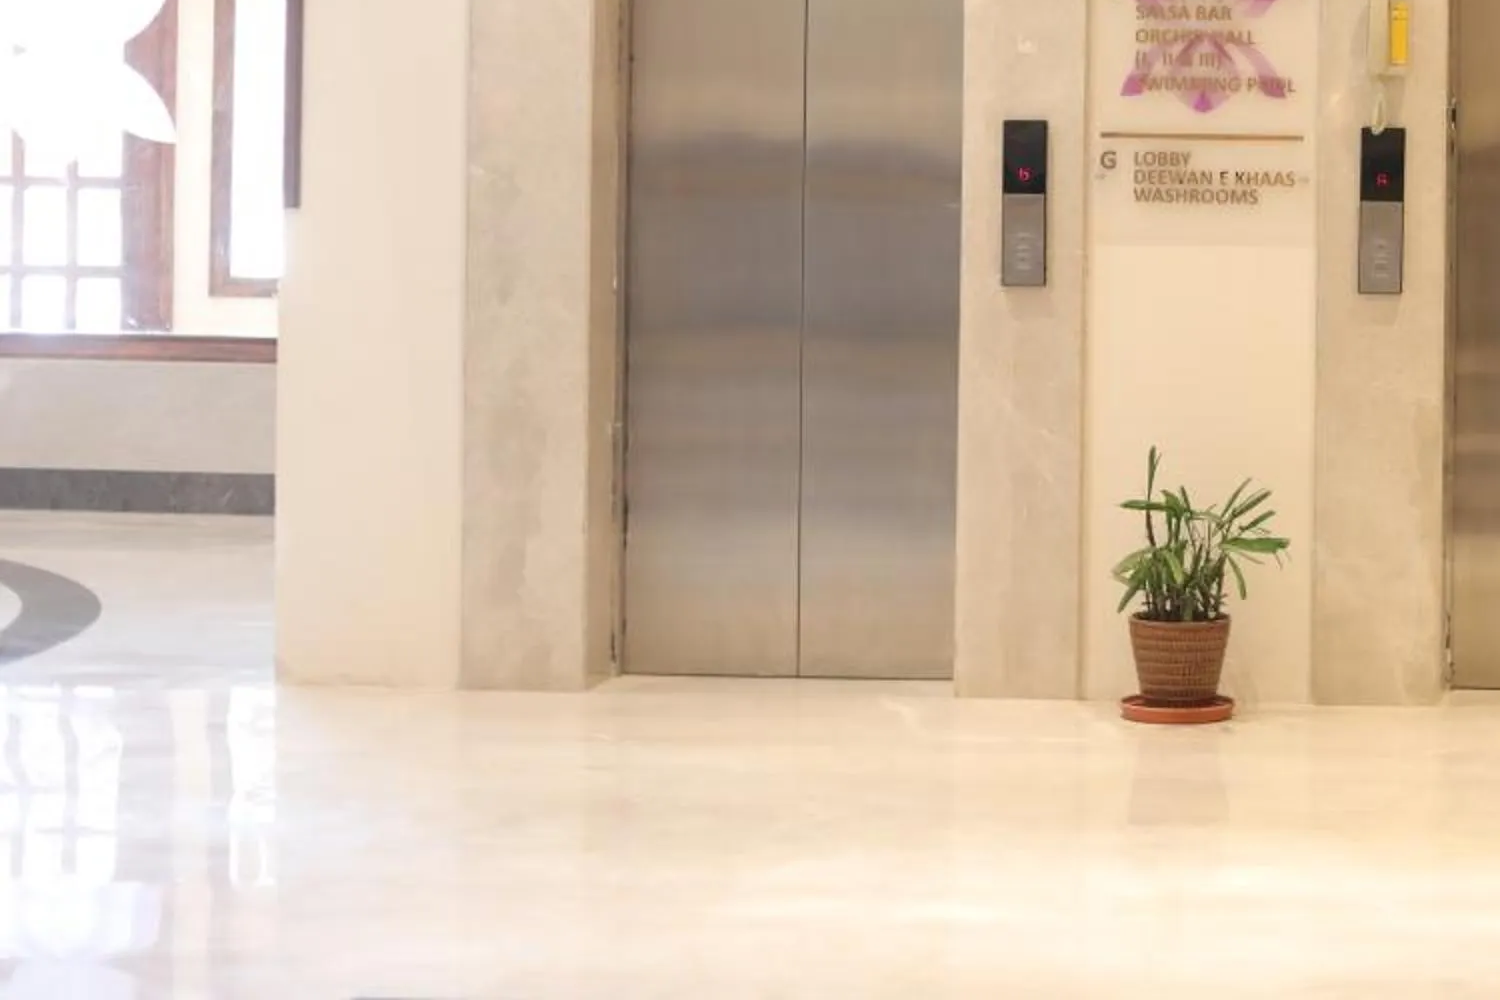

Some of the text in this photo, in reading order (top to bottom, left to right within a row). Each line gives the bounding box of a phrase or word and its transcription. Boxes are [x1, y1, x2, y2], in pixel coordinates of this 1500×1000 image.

[1136, 6, 1232, 21] SALSA BAR
[1212, 29, 1256, 45] ALL
[1247, 77, 1296, 93] PL
[1100, 151, 1117, 170] G
[1133, 151, 1192, 167] LOBBY
[1133, 170, 1213, 186] DEEWAN
[1235, 171, 1296, 188] KHAAS
[1133, 188, 1259, 205] WASHROOMS
